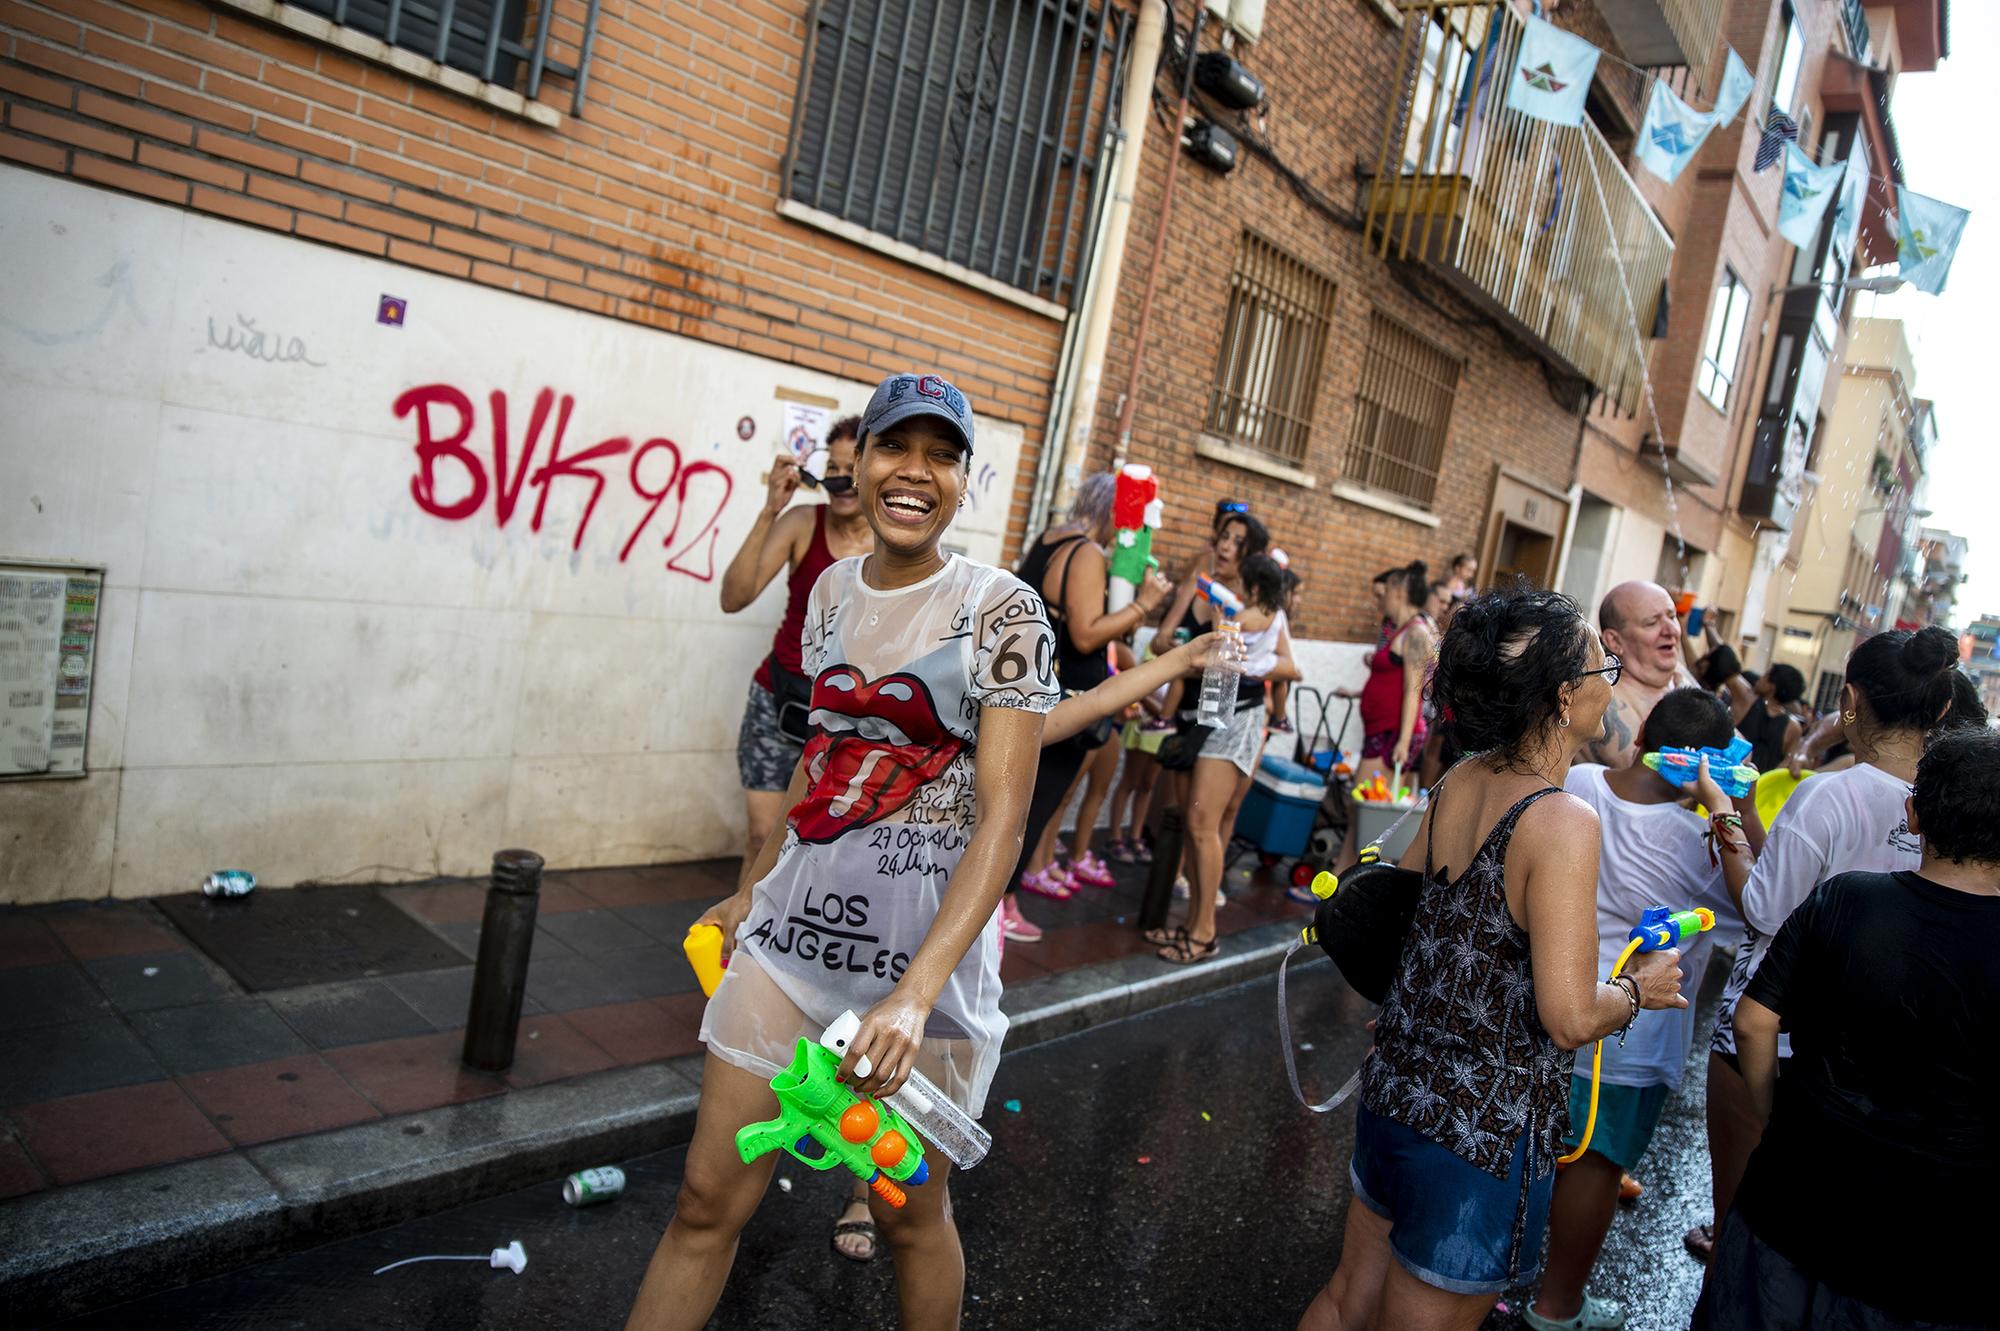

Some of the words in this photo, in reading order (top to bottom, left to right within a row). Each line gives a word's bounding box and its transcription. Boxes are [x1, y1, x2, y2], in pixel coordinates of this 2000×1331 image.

[888, 376, 965, 418] FCB
[989, 597, 1044, 636] ROUT
[803, 886, 870, 927] LOS
[744, 918, 910, 983] ANGELES
